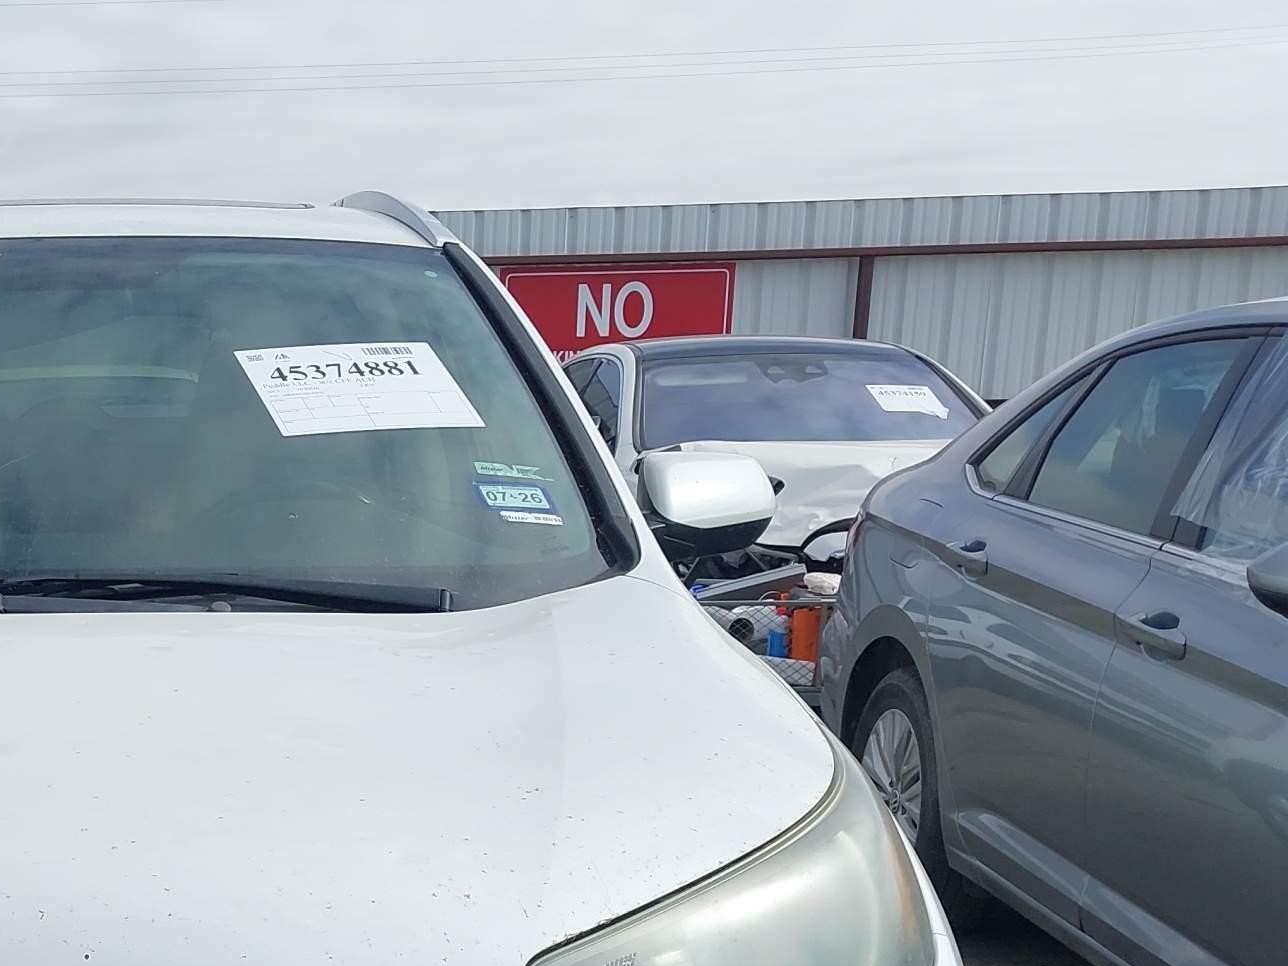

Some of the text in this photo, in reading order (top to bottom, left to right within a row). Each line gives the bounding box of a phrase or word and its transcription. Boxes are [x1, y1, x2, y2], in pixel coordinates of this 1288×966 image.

[576, 281, 654, 338] NO
[270, 360, 423, 381] 45374881
[486, 491, 543, 504] 07 26
